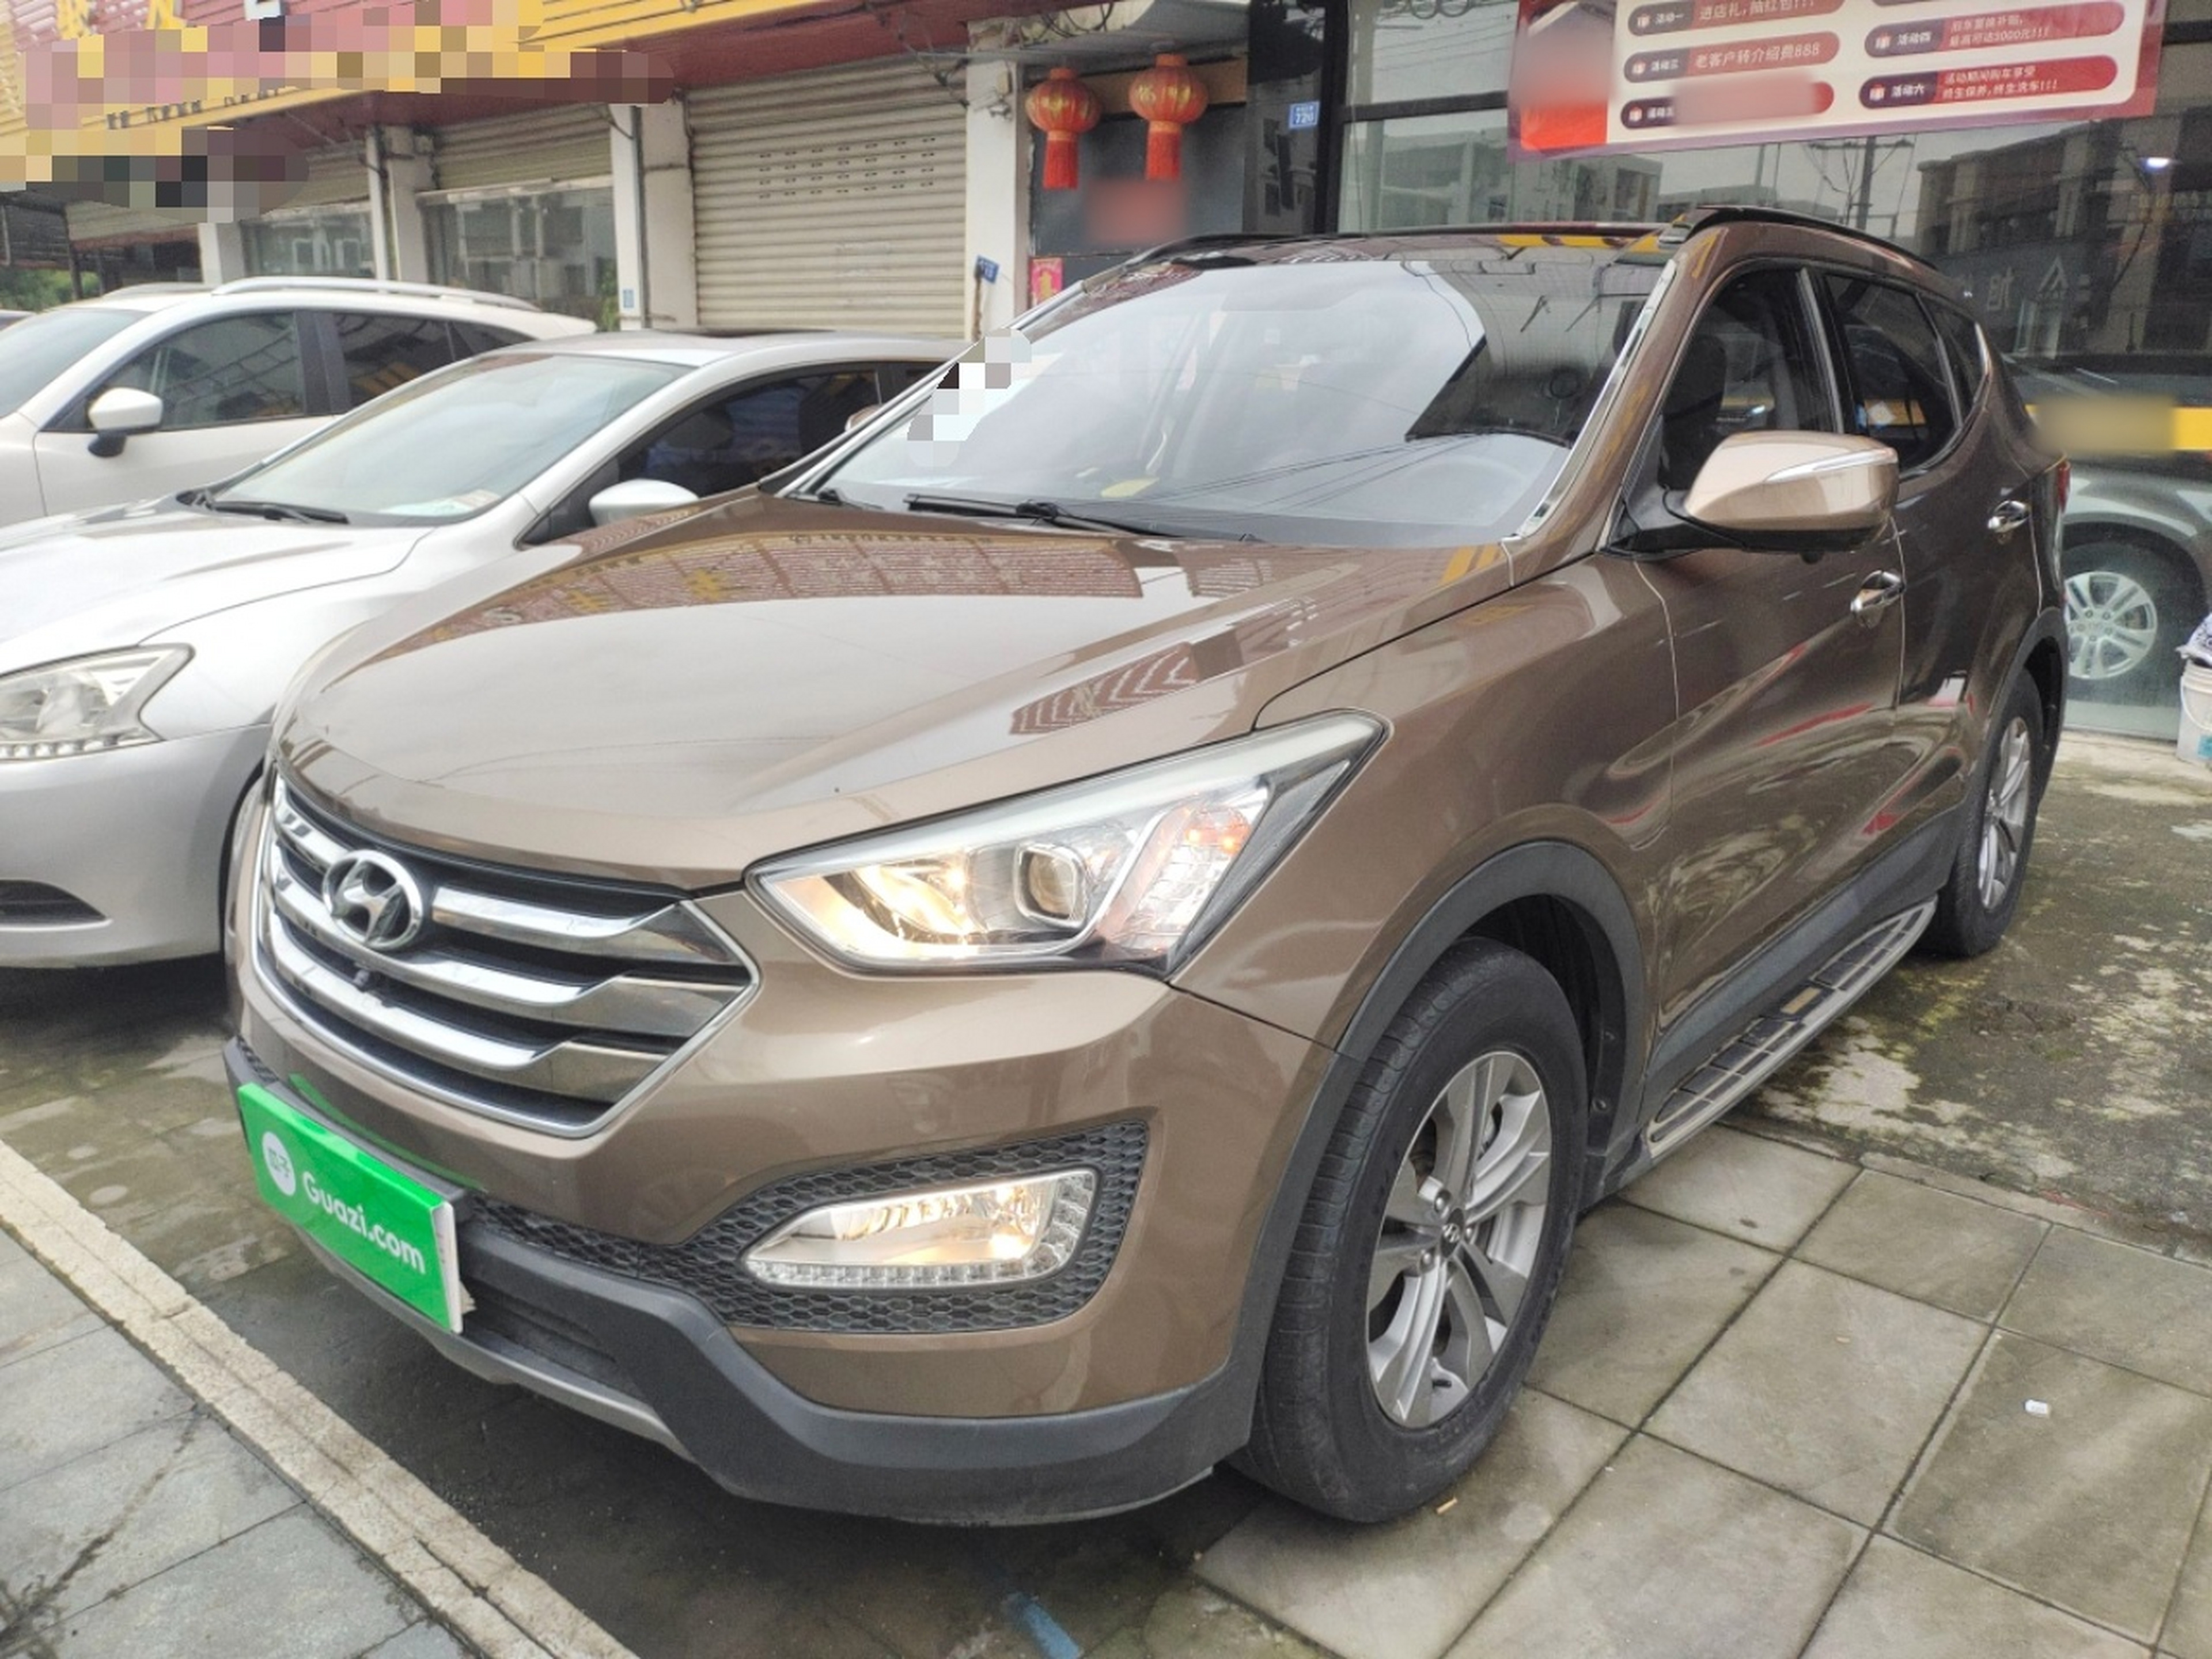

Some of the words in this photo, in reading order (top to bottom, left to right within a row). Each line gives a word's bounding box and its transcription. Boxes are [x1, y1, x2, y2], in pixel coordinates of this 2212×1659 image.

[1696, 43, 1820, 69] 老客户转介绍费888
[1945, 66, 2036, 84] 活动期间购车享受
[1891, 83, 1926, 98] 活动六
[302, 1171, 426, 1274] Guazi.com
